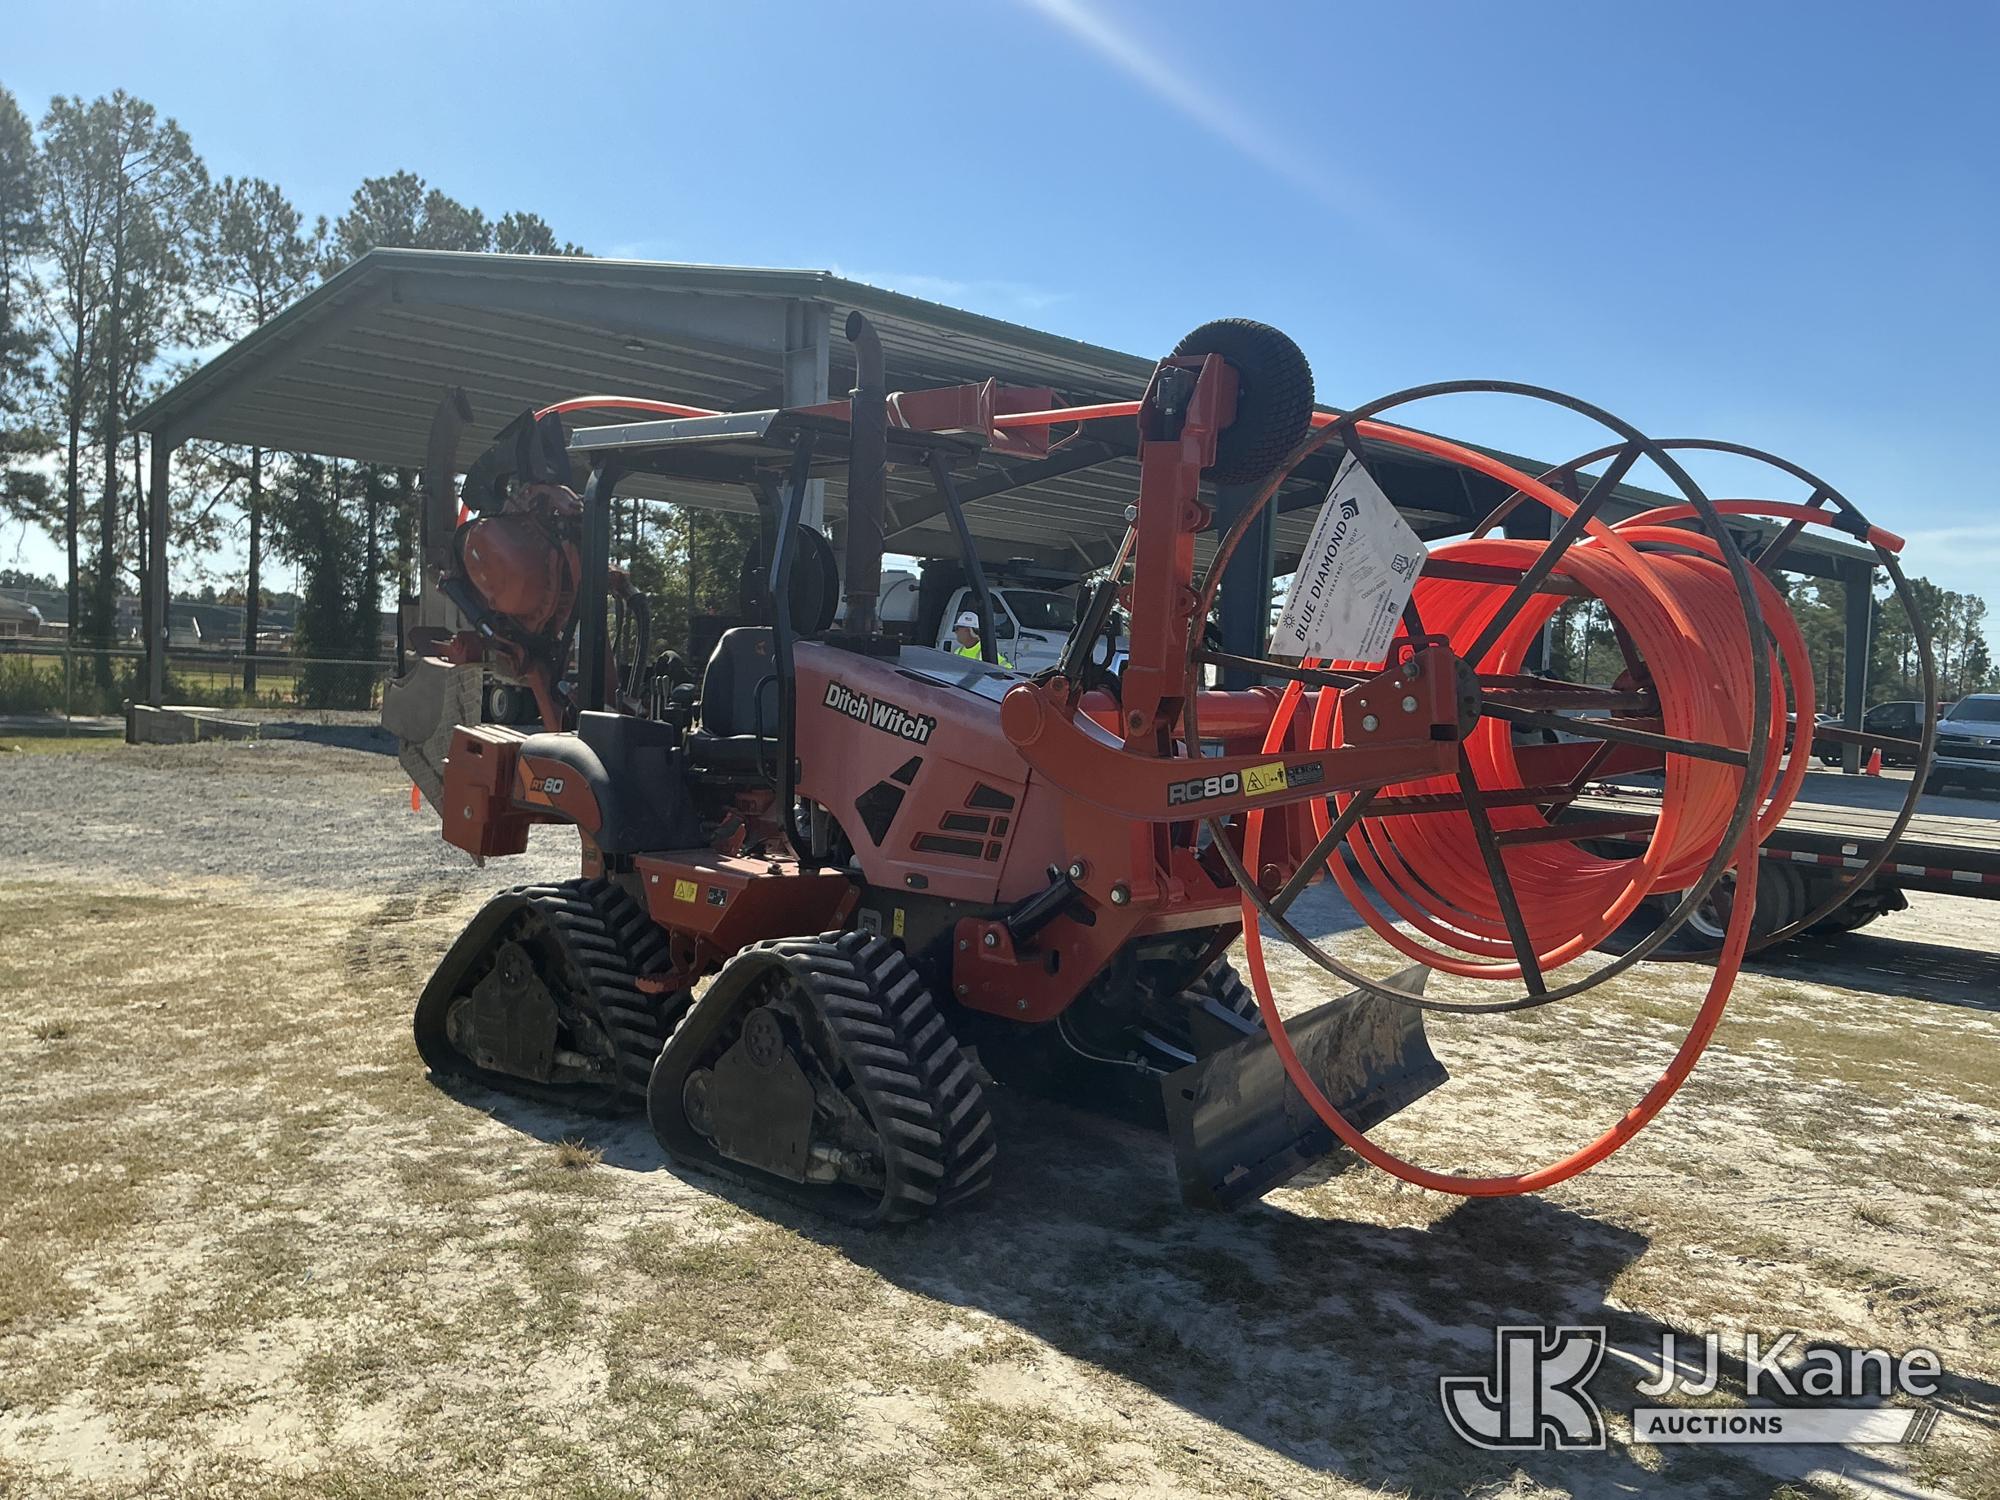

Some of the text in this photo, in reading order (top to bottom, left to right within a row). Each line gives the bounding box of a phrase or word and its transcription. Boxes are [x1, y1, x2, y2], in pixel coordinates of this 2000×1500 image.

[1296, 521, 1347, 642] BLUE DIAMOND
[825, 683, 929, 741] Ditch Witch
[532, 777, 564, 794] RT80
[1169, 773, 1239, 804] RC80
